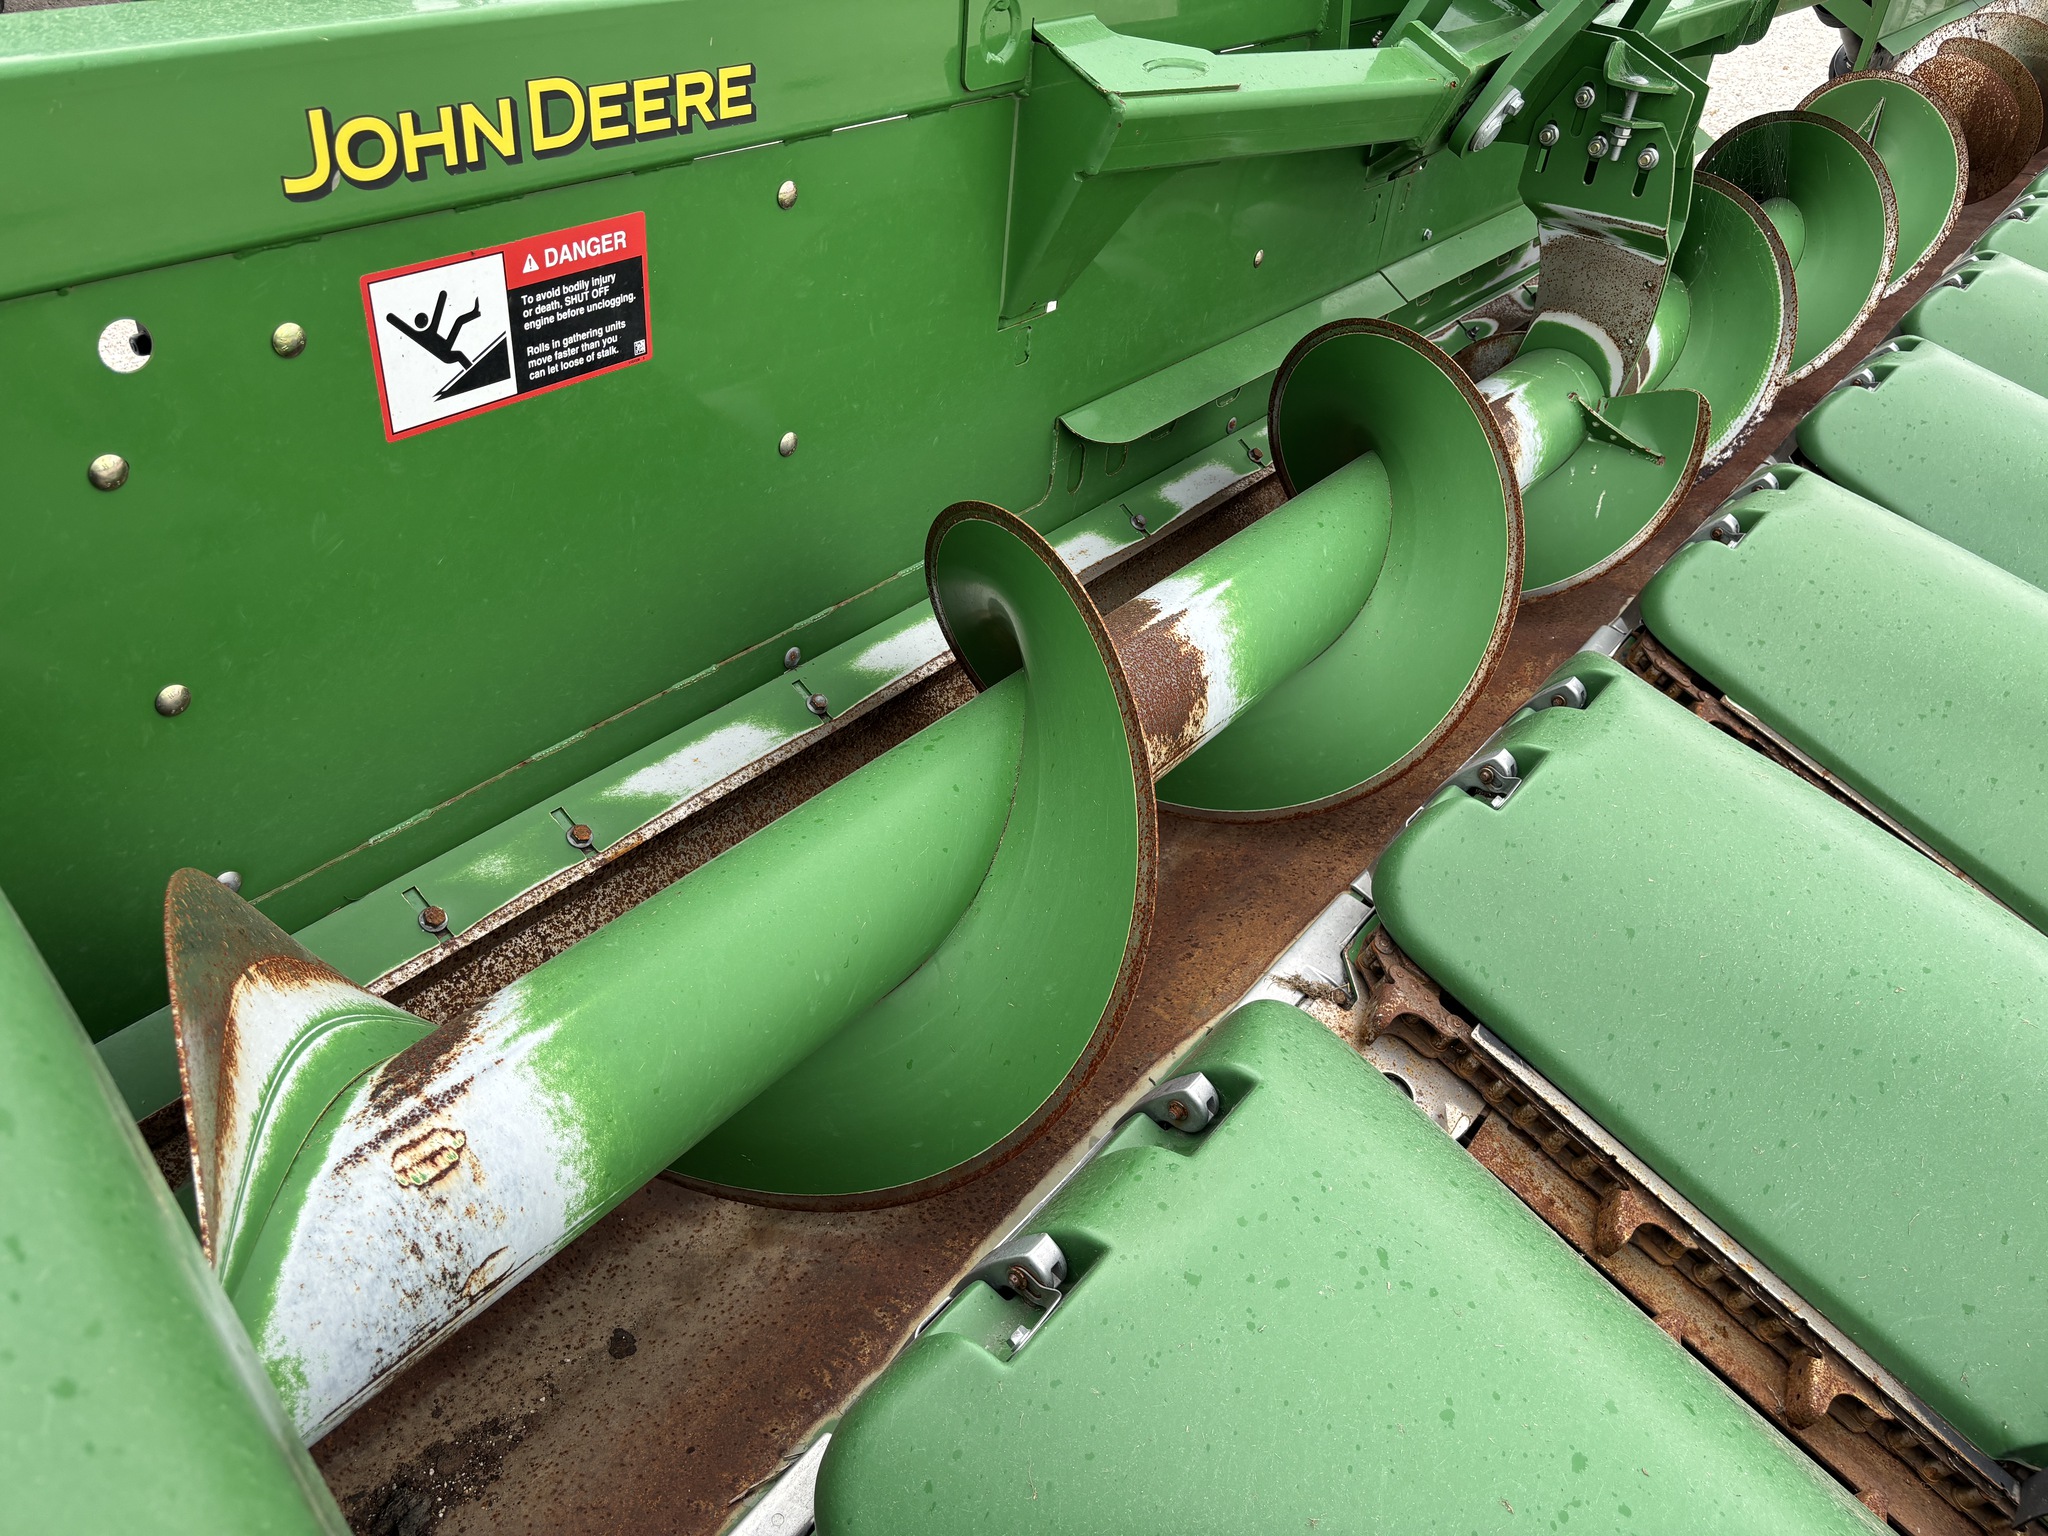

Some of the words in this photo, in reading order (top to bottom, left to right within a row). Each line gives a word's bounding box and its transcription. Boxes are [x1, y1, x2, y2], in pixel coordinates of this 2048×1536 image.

[281, 97, 522, 201] JOHN
[526, 62, 756, 160] DEERE
[544, 230, 627, 268] DANGER
[521, 295, 533, 305] To
[536, 287, 560, 301] avoid
[562, 279, 590, 295] bodily
[591, 274, 616, 285] injury
[523, 309, 533, 318] or
[535, 301, 563, 315] death,
[565, 292, 589, 306] SHUT
[592, 286, 609, 299] OFF
[524, 315, 555, 331] engine
[557, 307, 584, 321] before
[587, 292, 636, 313] unclogging.
[527, 343, 550, 356] Rolls
[552, 339, 560, 349] in
[563, 326, 603, 346] gathering
[605, 320, 626, 333] units
[528, 355, 553, 368] move
[554, 347, 579, 360] faster
[581, 340, 600, 352] than
[602, 335, 618, 348] you
[529, 367, 545, 380] can
[548, 363, 559, 375] let
[560, 356, 584, 370] loose
[586, 352, 595, 362] of
[597, 346, 619, 360] stalk.
